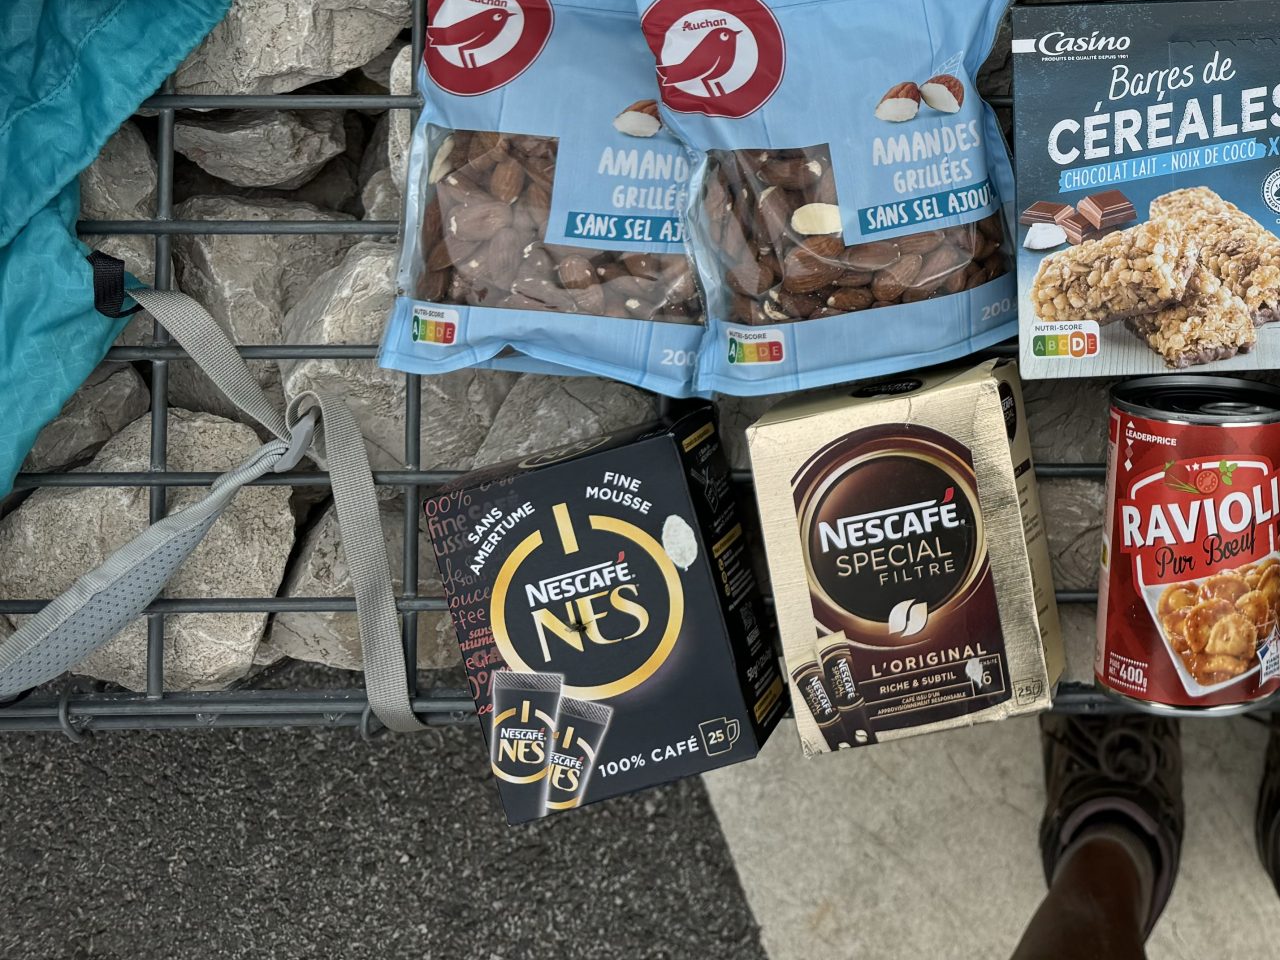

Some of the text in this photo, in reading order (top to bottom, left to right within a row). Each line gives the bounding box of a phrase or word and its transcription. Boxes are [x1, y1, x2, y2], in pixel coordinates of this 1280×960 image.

[682, 17, 728, 32] Auchan
[1038, 31, 1131, 56] Casino
[1108, 50, 1236, 101] Barres de
[872, 119, 981, 166] AMANDES
[598, 147, 689, 183] AMAND
[893, 157, 972, 194] GRILLÉES
[1064, 140, 1257, 190] CHOCOLAT LAIT NOIX DE COCO
[574, 214, 653, 240] SANS SEL
[866, 203, 909, 230] SANS
[913, 196, 943, 221] SEL
[1034, 324, 1083, 332] NUTRI-SCORE
[1126, 429, 1177, 447] LEADERPRICE
[603, 471, 642, 492] FINE
[585, 486, 653, 514] MOUSSE
[1121, 476, 1280, 548] RAVIOLI
[468, 506, 504, 545] SANS
[818, 486, 958, 553] NESCAFÉ
[469, 501, 536, 576] AMERTUME
[836, 537, 952, 577] SPECIAL
[1155, 546, 1195, 578] Pur
[524, 551, 634, 607] NESCAFÉ
[879, 560, 956, 587] FILTRE
[531, 583, 650, 662] NES
[871, 642, 987, 678] L'ORIGINAL
[879, 671, 957, 694] RICHE & SUBTIL
[983, 670, 992, 685] 6
[902, 695, 915, 704] CAFÉ
[931, 691, 967, 705] RESPONSABLE
[500, 727, 546, 740] NESCAFÉ
[708, 729, 725, 744] 25
[498, 739, 545, 764] NES
[550, 751, 584, 769] ESCAFÉ
[599, 737, 700, 778] 100% CAFÉ
